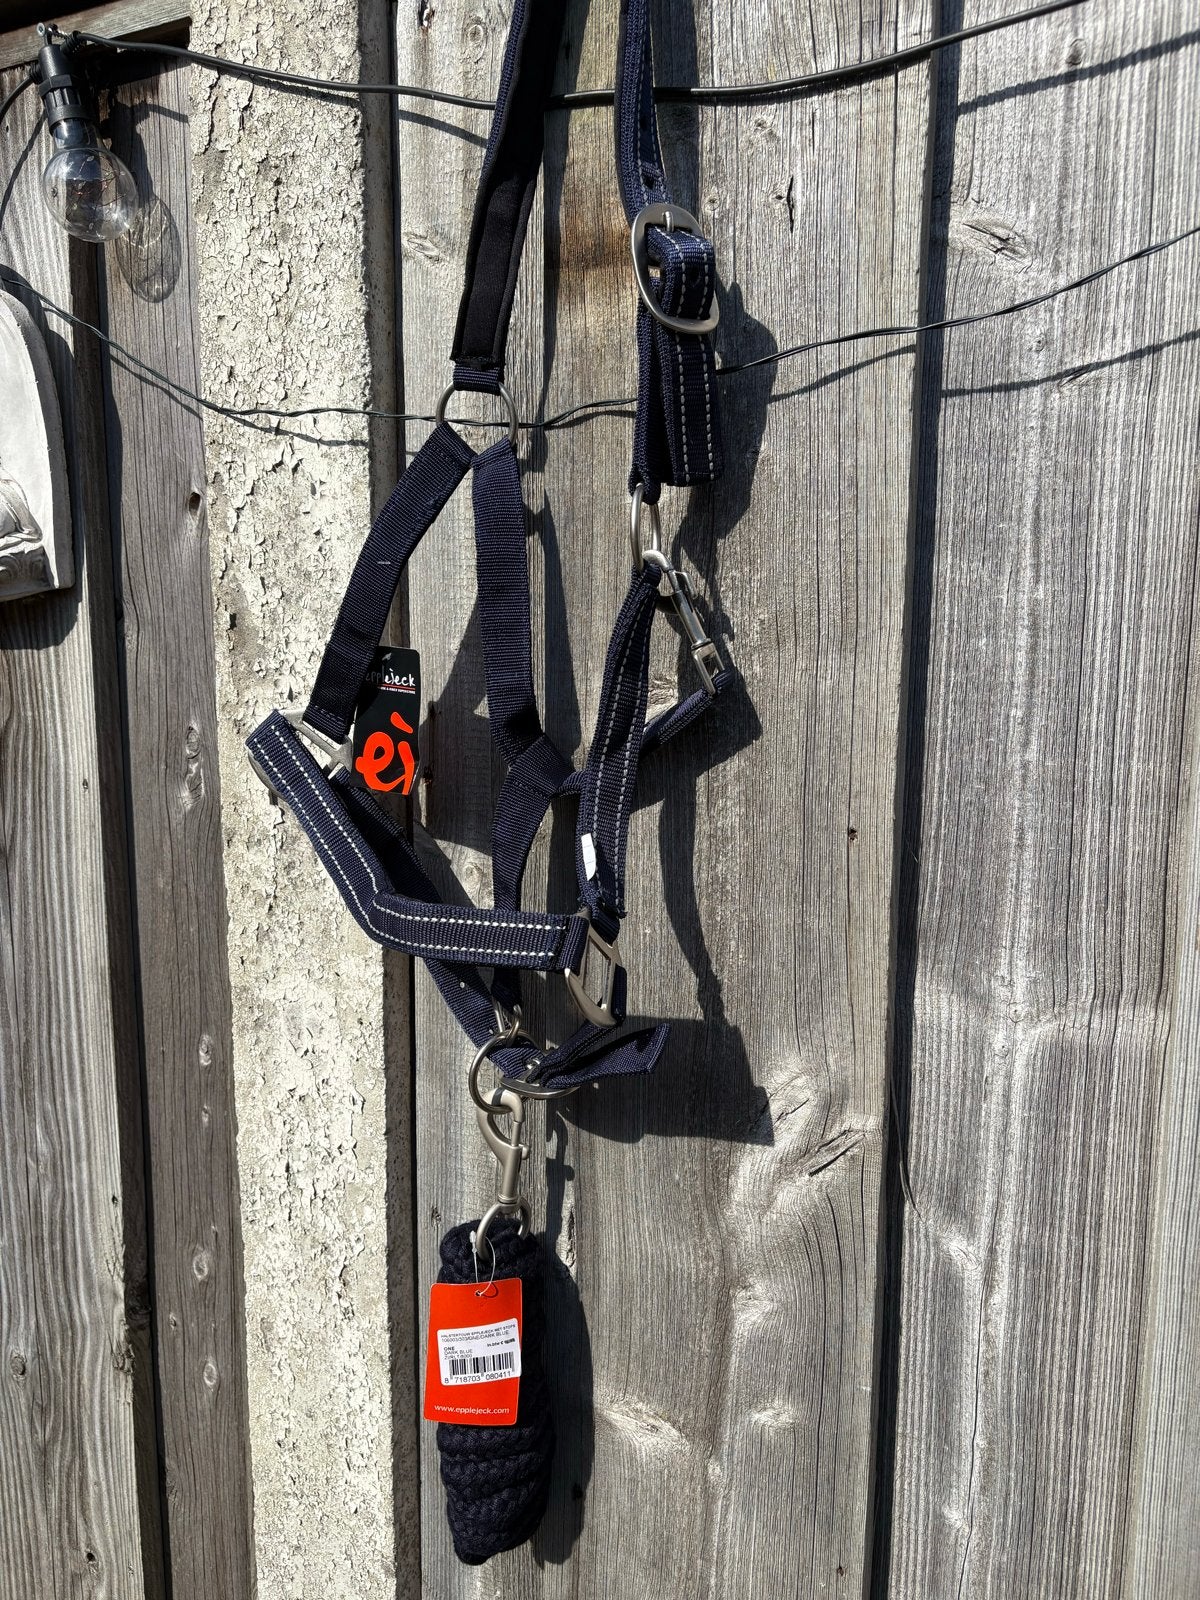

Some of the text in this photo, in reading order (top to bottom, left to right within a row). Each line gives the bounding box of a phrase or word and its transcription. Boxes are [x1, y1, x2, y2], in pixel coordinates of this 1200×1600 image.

[455, 1375, 481, 1383] 718703
[485, 1371, 511, 1380] 080411
[434, 1405, 510, 1415] www.epplejeck.com
